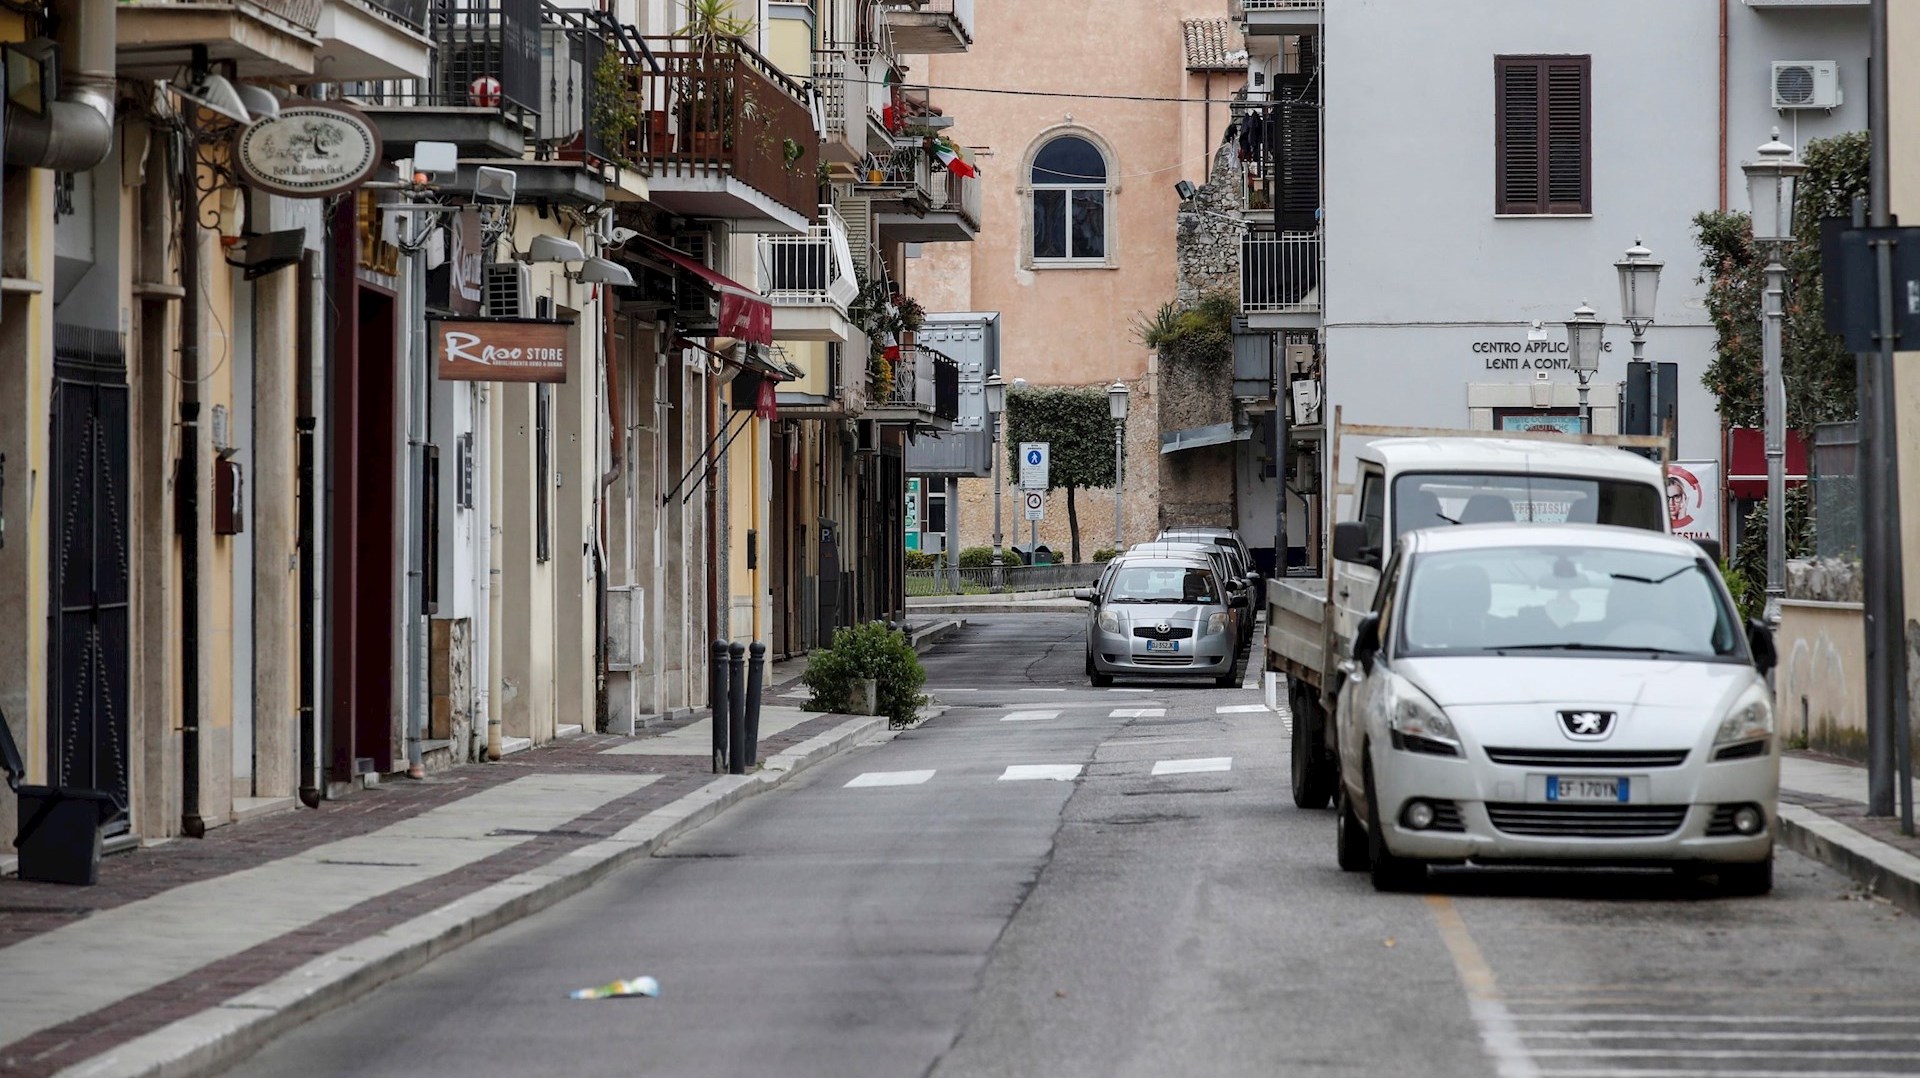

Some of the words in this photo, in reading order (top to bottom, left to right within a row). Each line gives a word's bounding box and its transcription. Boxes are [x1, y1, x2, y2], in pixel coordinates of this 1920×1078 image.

[273, 165, 290, 175] Bed
[292, 165, 299, 175] &
[301, 164, 344, 175] Breakfast
[445, 331, 522, 366] Raso
[526, 347, 564, 361] STORE
[1472, 341, 1522, 353] CENTRO
[1486, 358, 1519, 370] LENTI
[1522, 358, 1532, 370] A
[821, 528, 831, 541] P
[1559, 781, 1573, 798] EF
